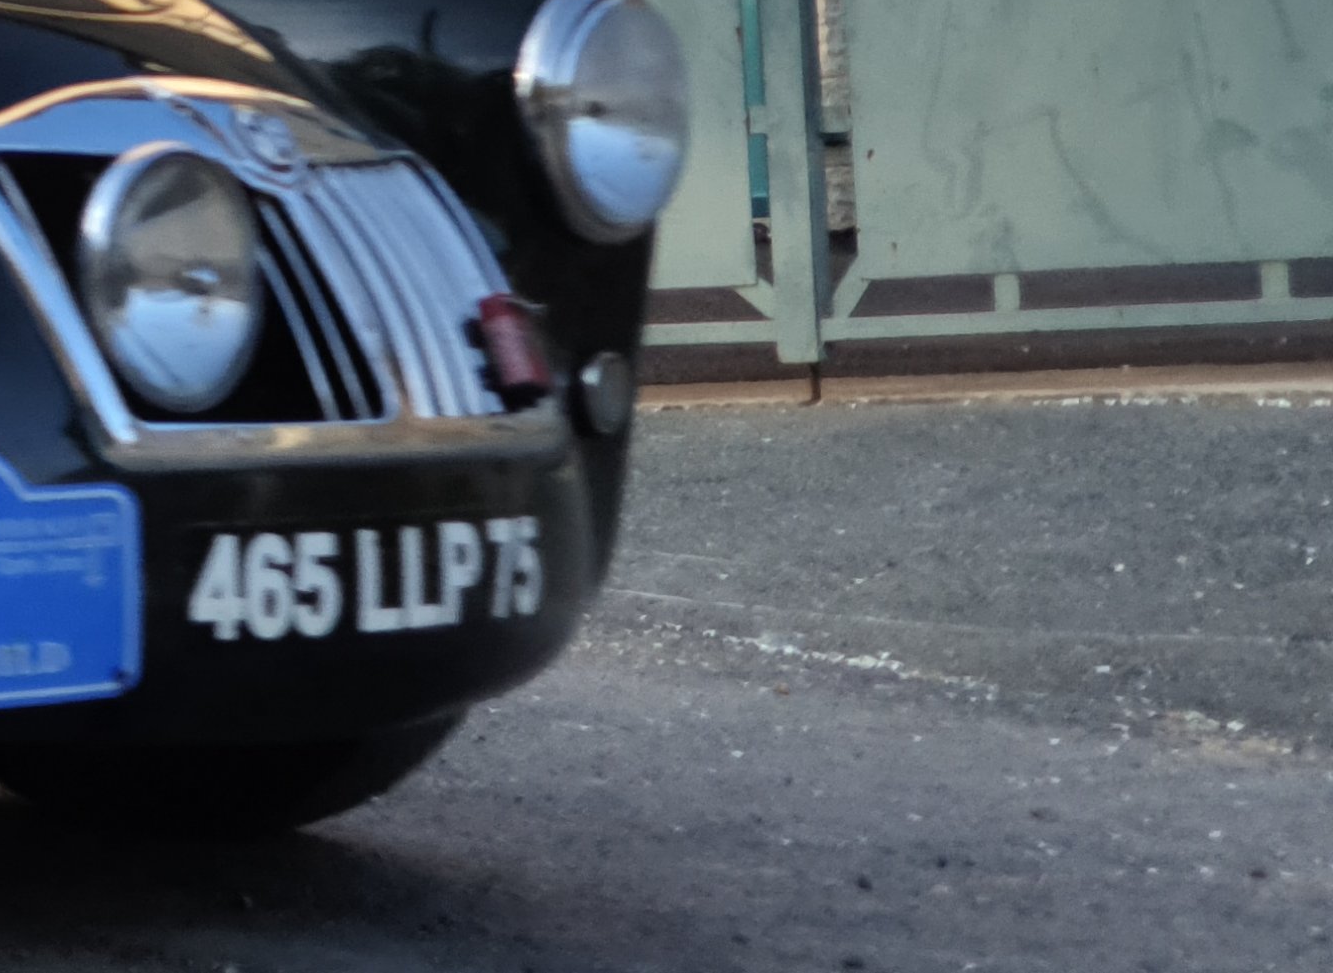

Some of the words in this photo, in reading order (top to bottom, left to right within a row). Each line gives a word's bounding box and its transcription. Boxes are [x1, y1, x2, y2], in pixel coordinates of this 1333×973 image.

[188, 532, 343, 641] 465
[354, 521, 483, 633] LLP
[485, 515, 543, 619] 75
